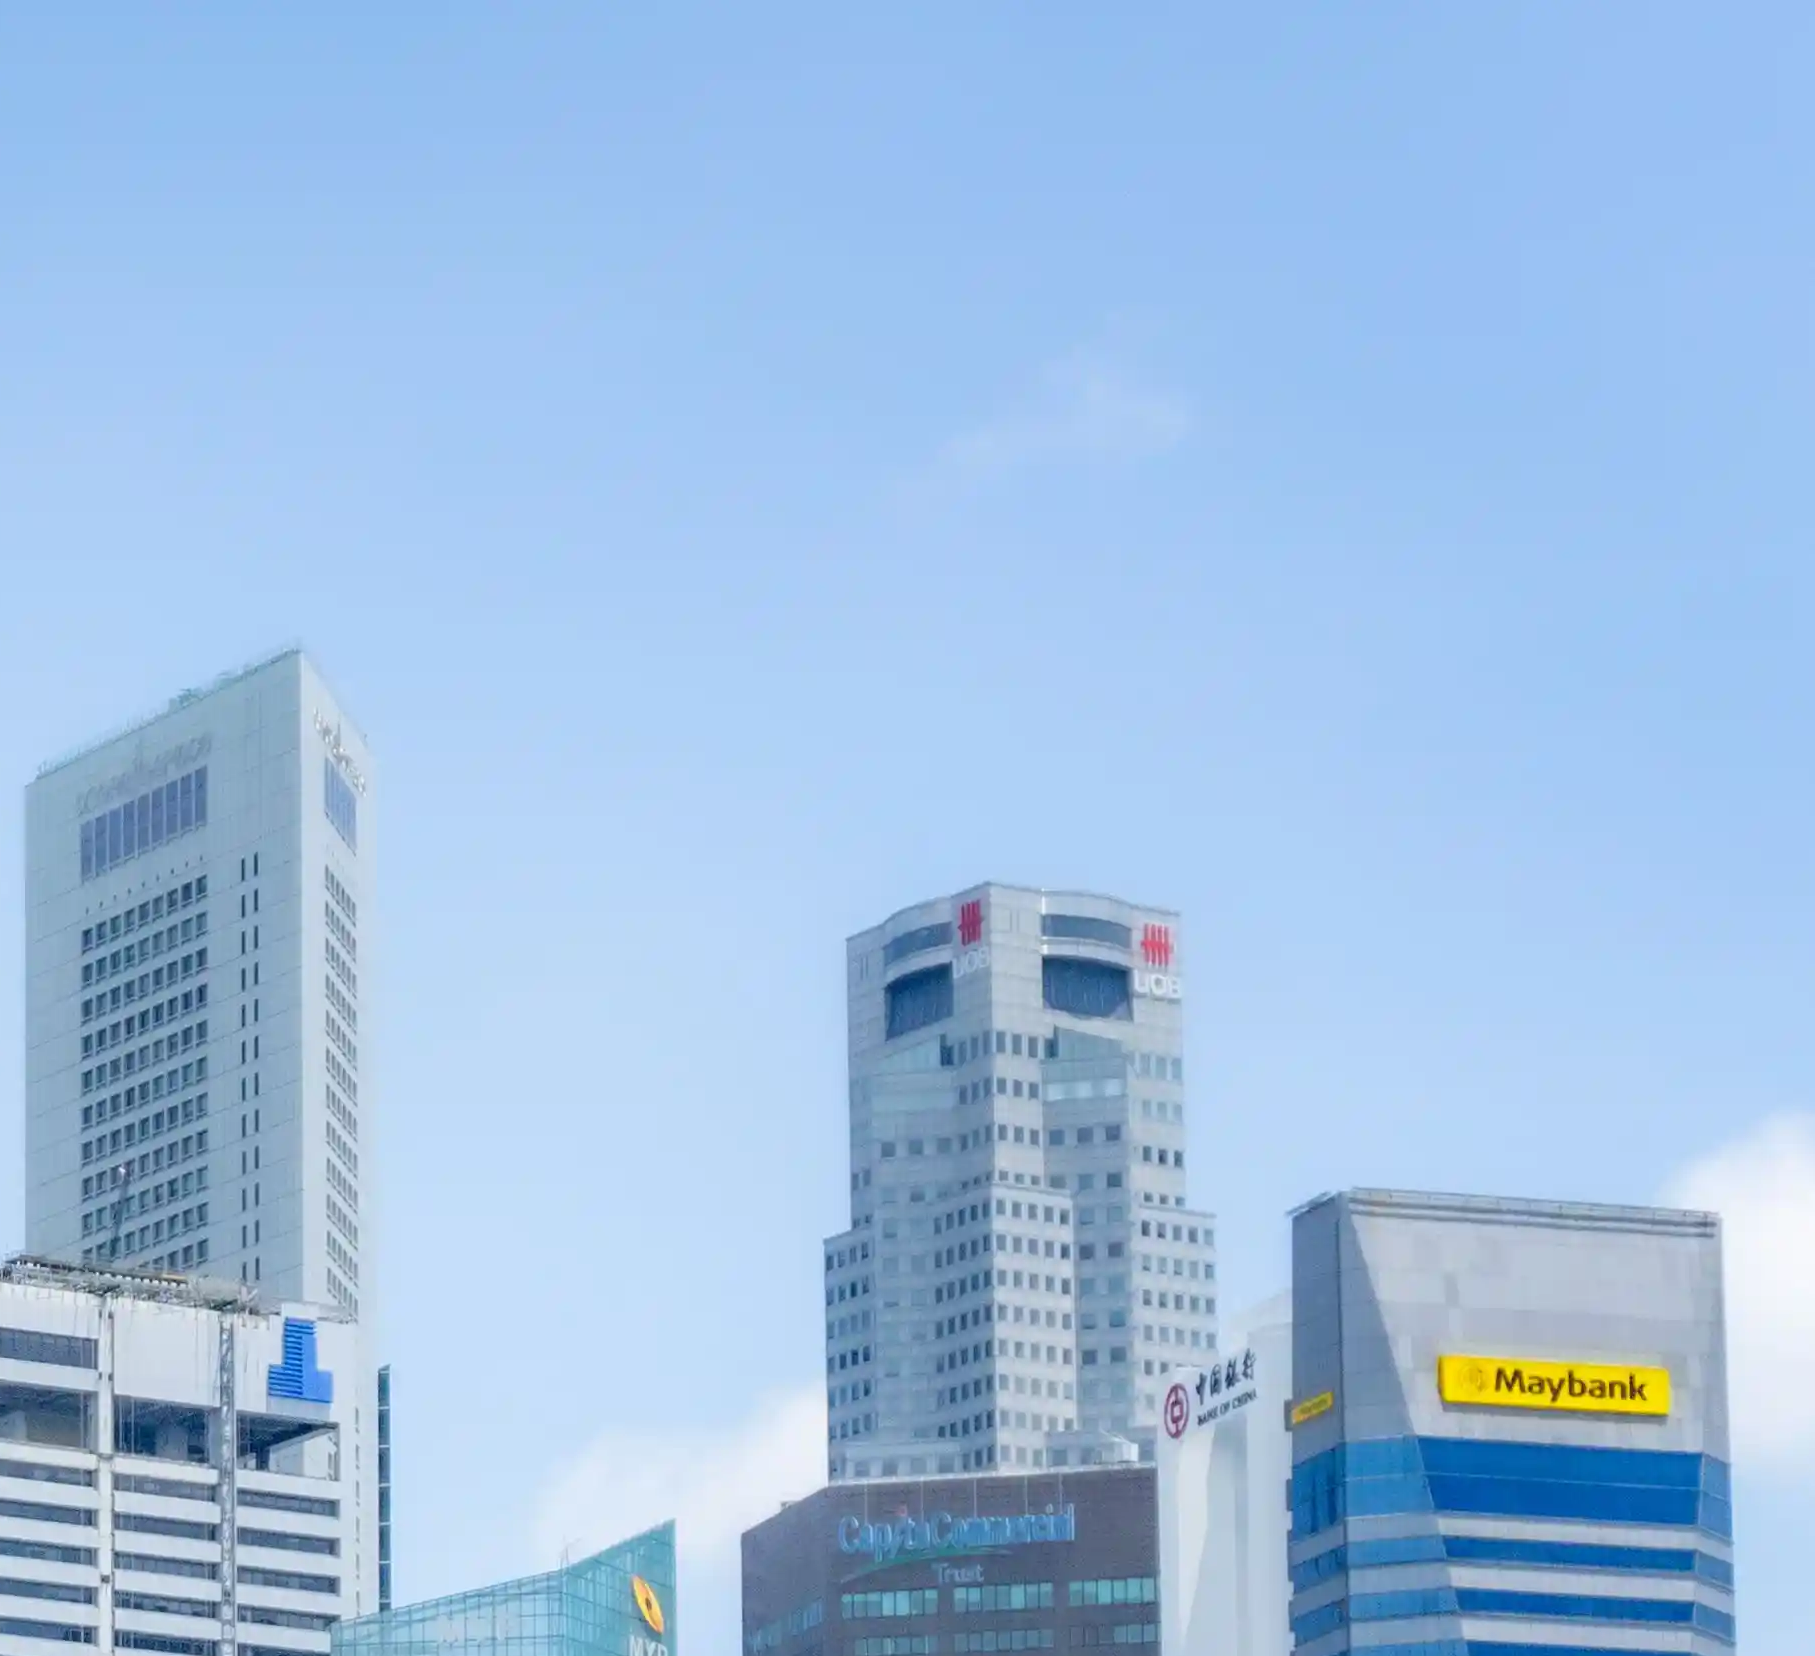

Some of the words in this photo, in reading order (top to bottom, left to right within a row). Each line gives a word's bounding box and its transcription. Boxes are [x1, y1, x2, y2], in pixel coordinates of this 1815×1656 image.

[1133, 969, 1182, 998] UOB
[1494, 1367, 1648, 1403] Maybank
[931, 1563, 985, 1585] Trust
